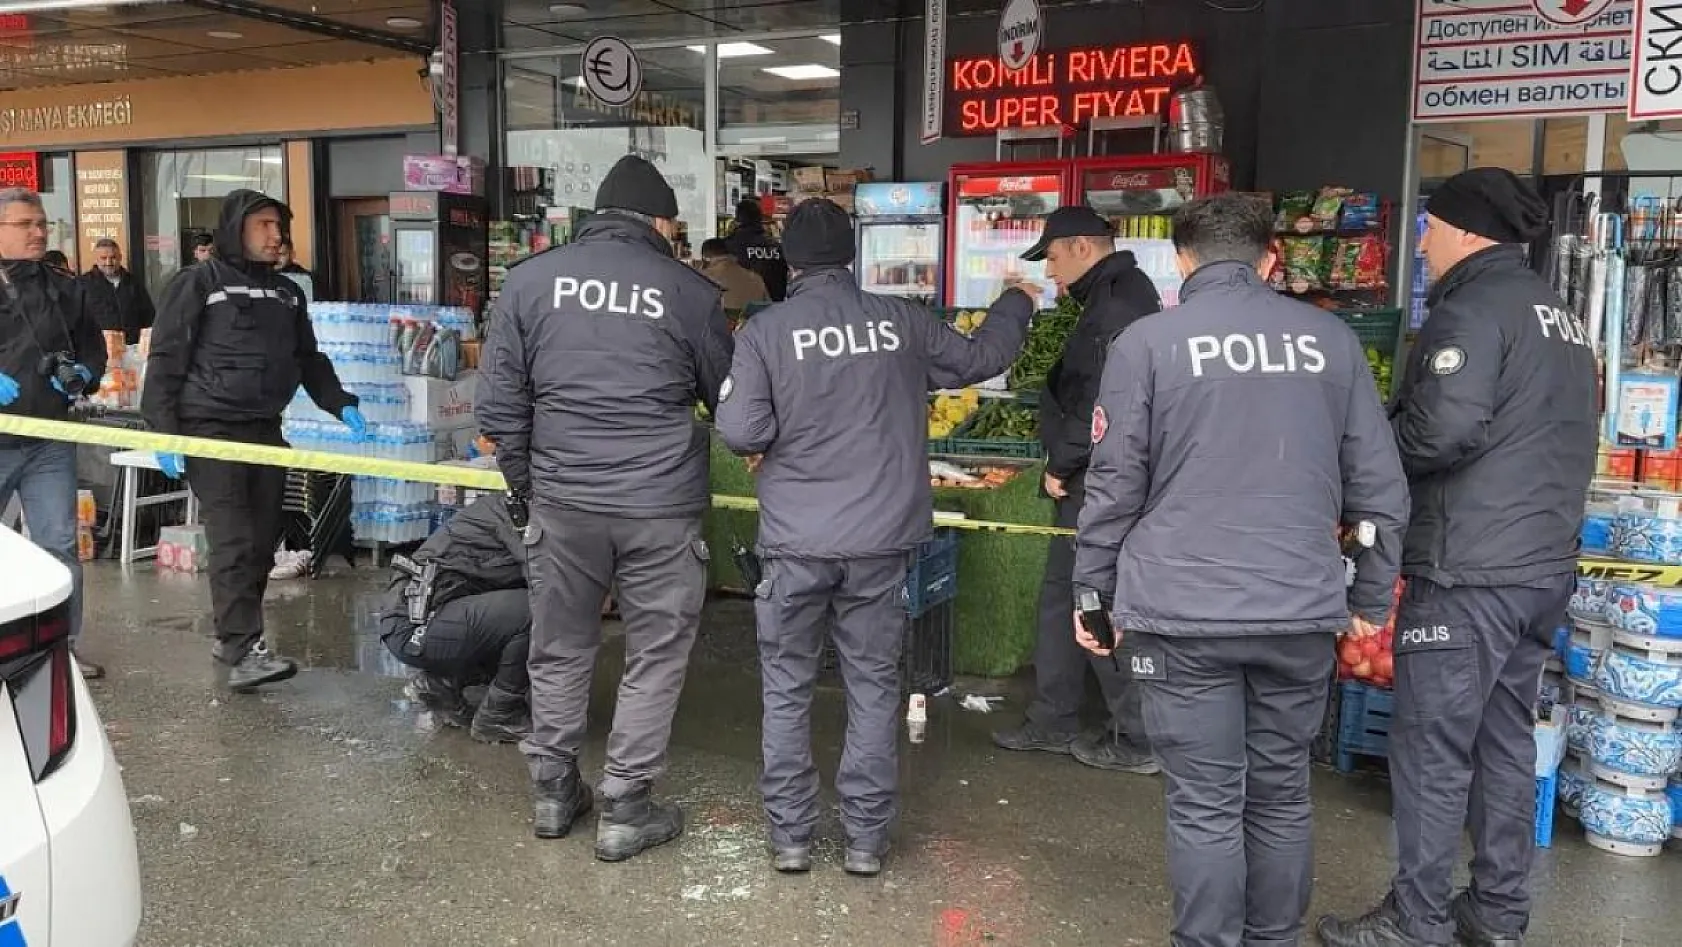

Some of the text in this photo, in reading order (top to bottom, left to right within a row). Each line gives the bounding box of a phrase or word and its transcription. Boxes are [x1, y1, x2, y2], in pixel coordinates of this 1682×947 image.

[1427, 7, 1633, 41] Доступен ирнет
[1511, 42, 1569, 68] SIM
[1425, 81, 1625, 107] обмен валюты
[962, 95, 1062, 130] SUPER
[1131, 656, 1154, 675] OLIS
